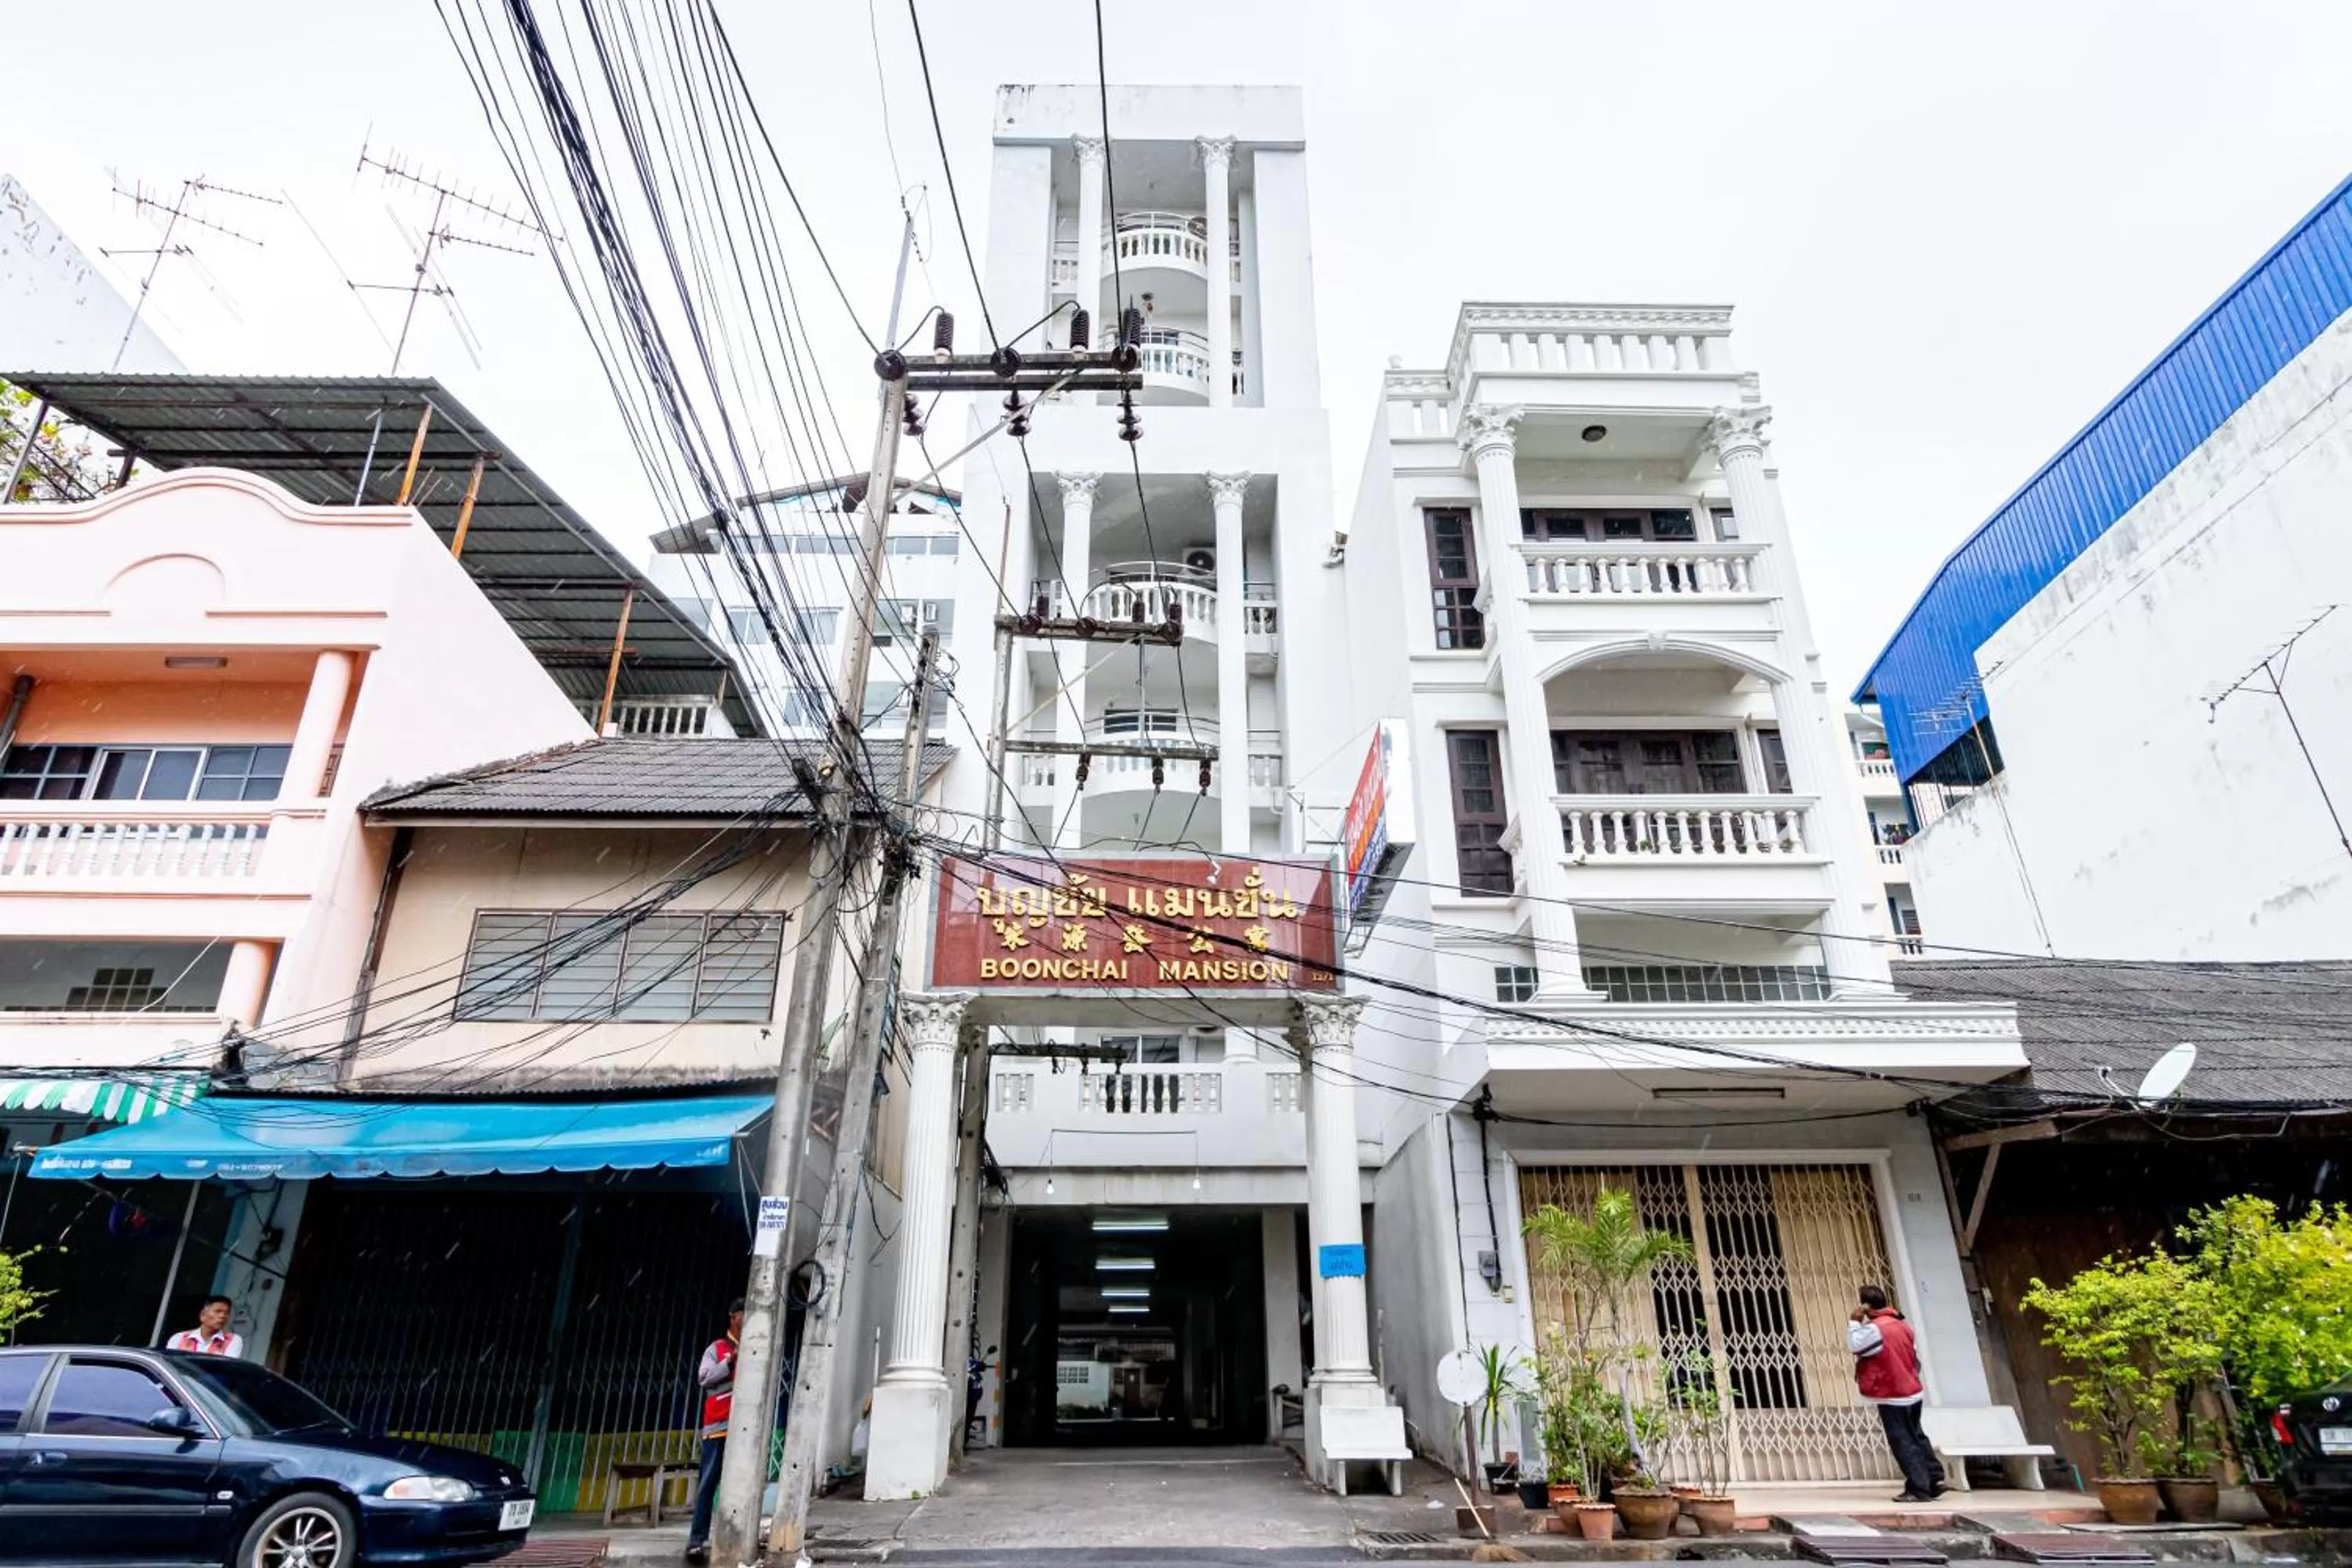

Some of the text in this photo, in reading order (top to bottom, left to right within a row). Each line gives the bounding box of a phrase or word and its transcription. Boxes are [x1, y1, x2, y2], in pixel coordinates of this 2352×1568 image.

[977, 873, 1106, 934] บุญชัย
[981, 957, 1289, 981] BOONCHAI MANSION
